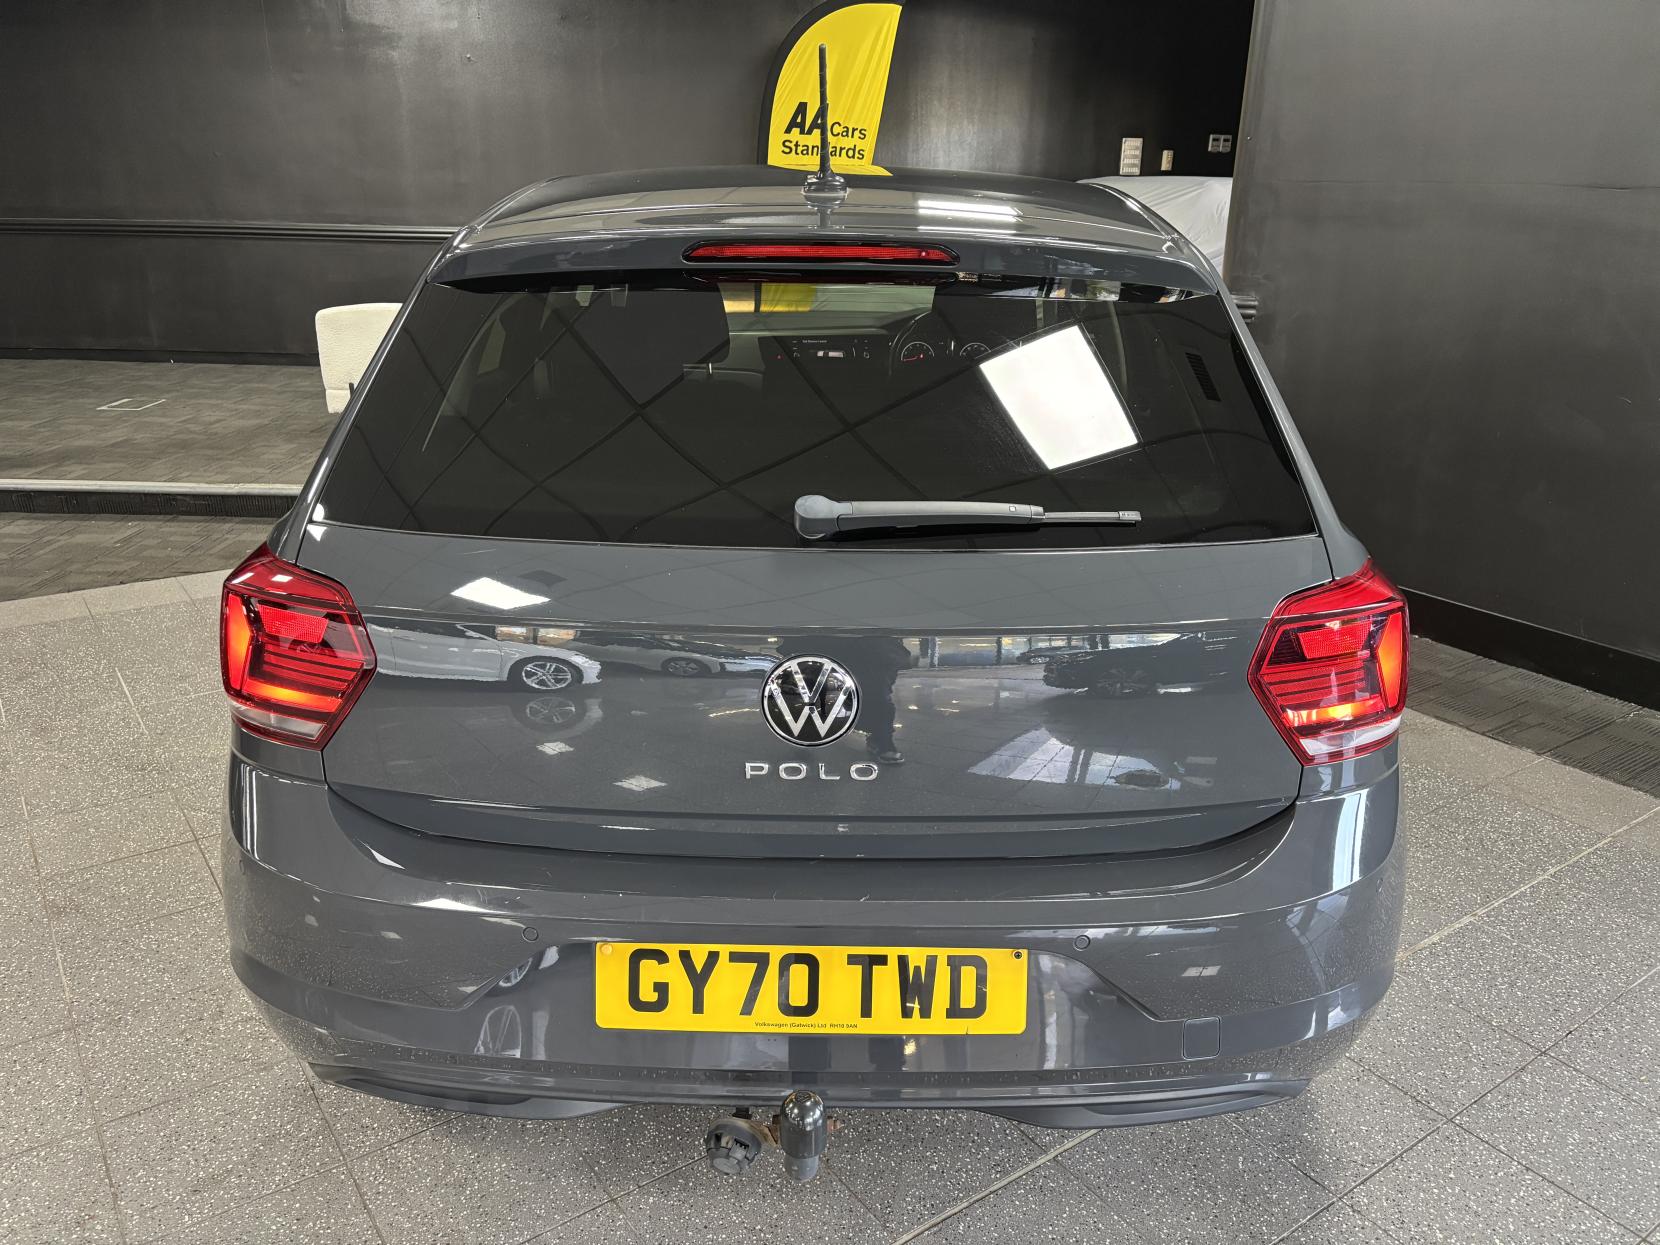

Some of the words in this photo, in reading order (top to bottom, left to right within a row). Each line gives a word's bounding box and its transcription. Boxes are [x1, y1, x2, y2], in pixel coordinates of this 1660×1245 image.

[784, 101, 829, 136] AA
[830, 122, 867, 140] Cars
[781, 139, 865, 160] Stanards
[766, 658, 855, 742] VW
[745, 762, 878, 781] POLO
[628, 948, 820, 1018] GY70
[847, 954, 988, 1019] TWD
